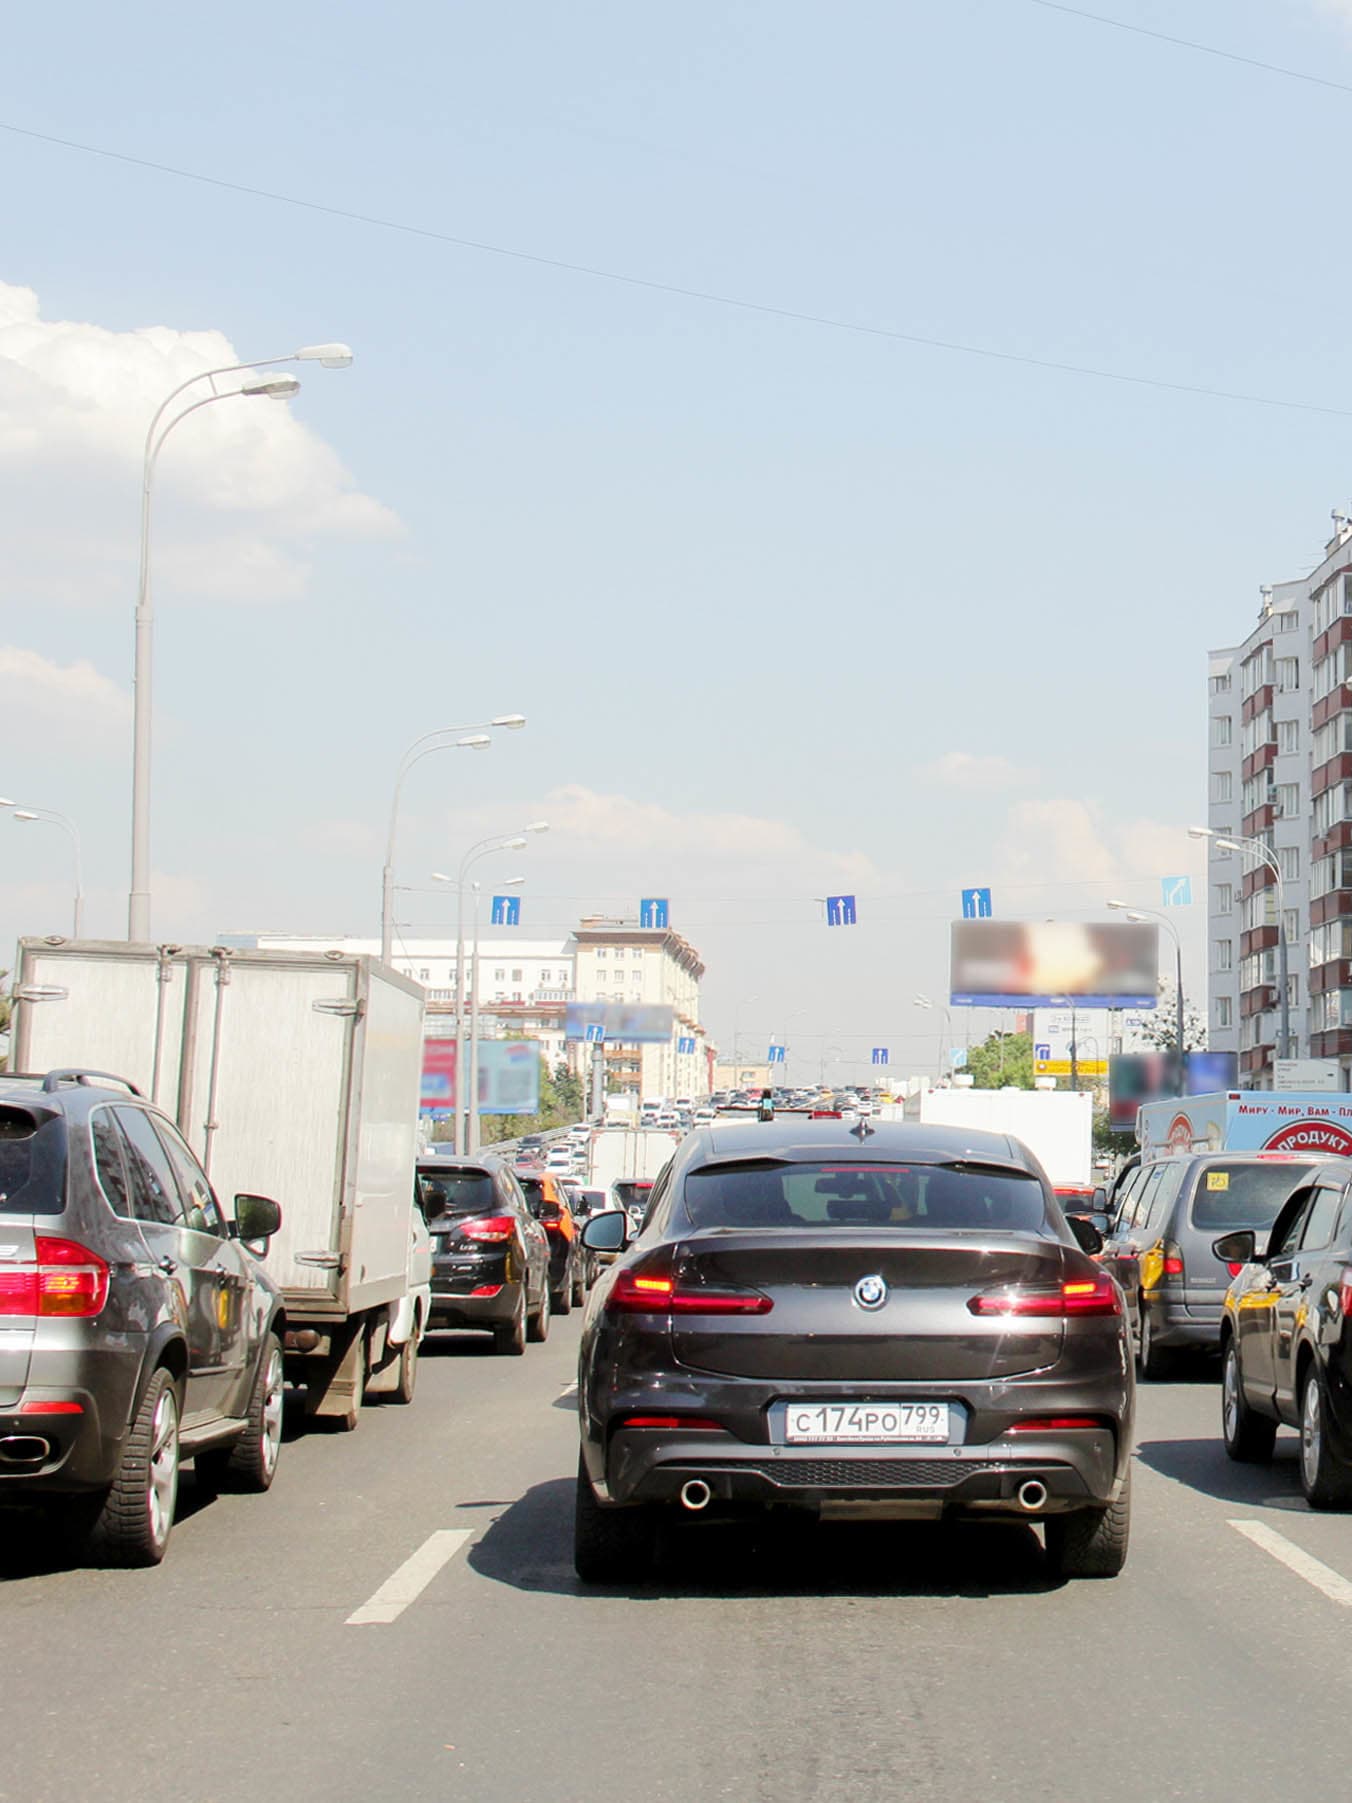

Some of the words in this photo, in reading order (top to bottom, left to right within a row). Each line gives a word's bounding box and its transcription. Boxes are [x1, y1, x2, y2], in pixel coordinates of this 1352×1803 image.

[1277, 1131, 1349, 1151] ПРОДУКТ
[796, 1407, 897, 1433] С174РО
[902, 1405, 941, 1426] 799
[916, 1425, 936, 1434] RUS
